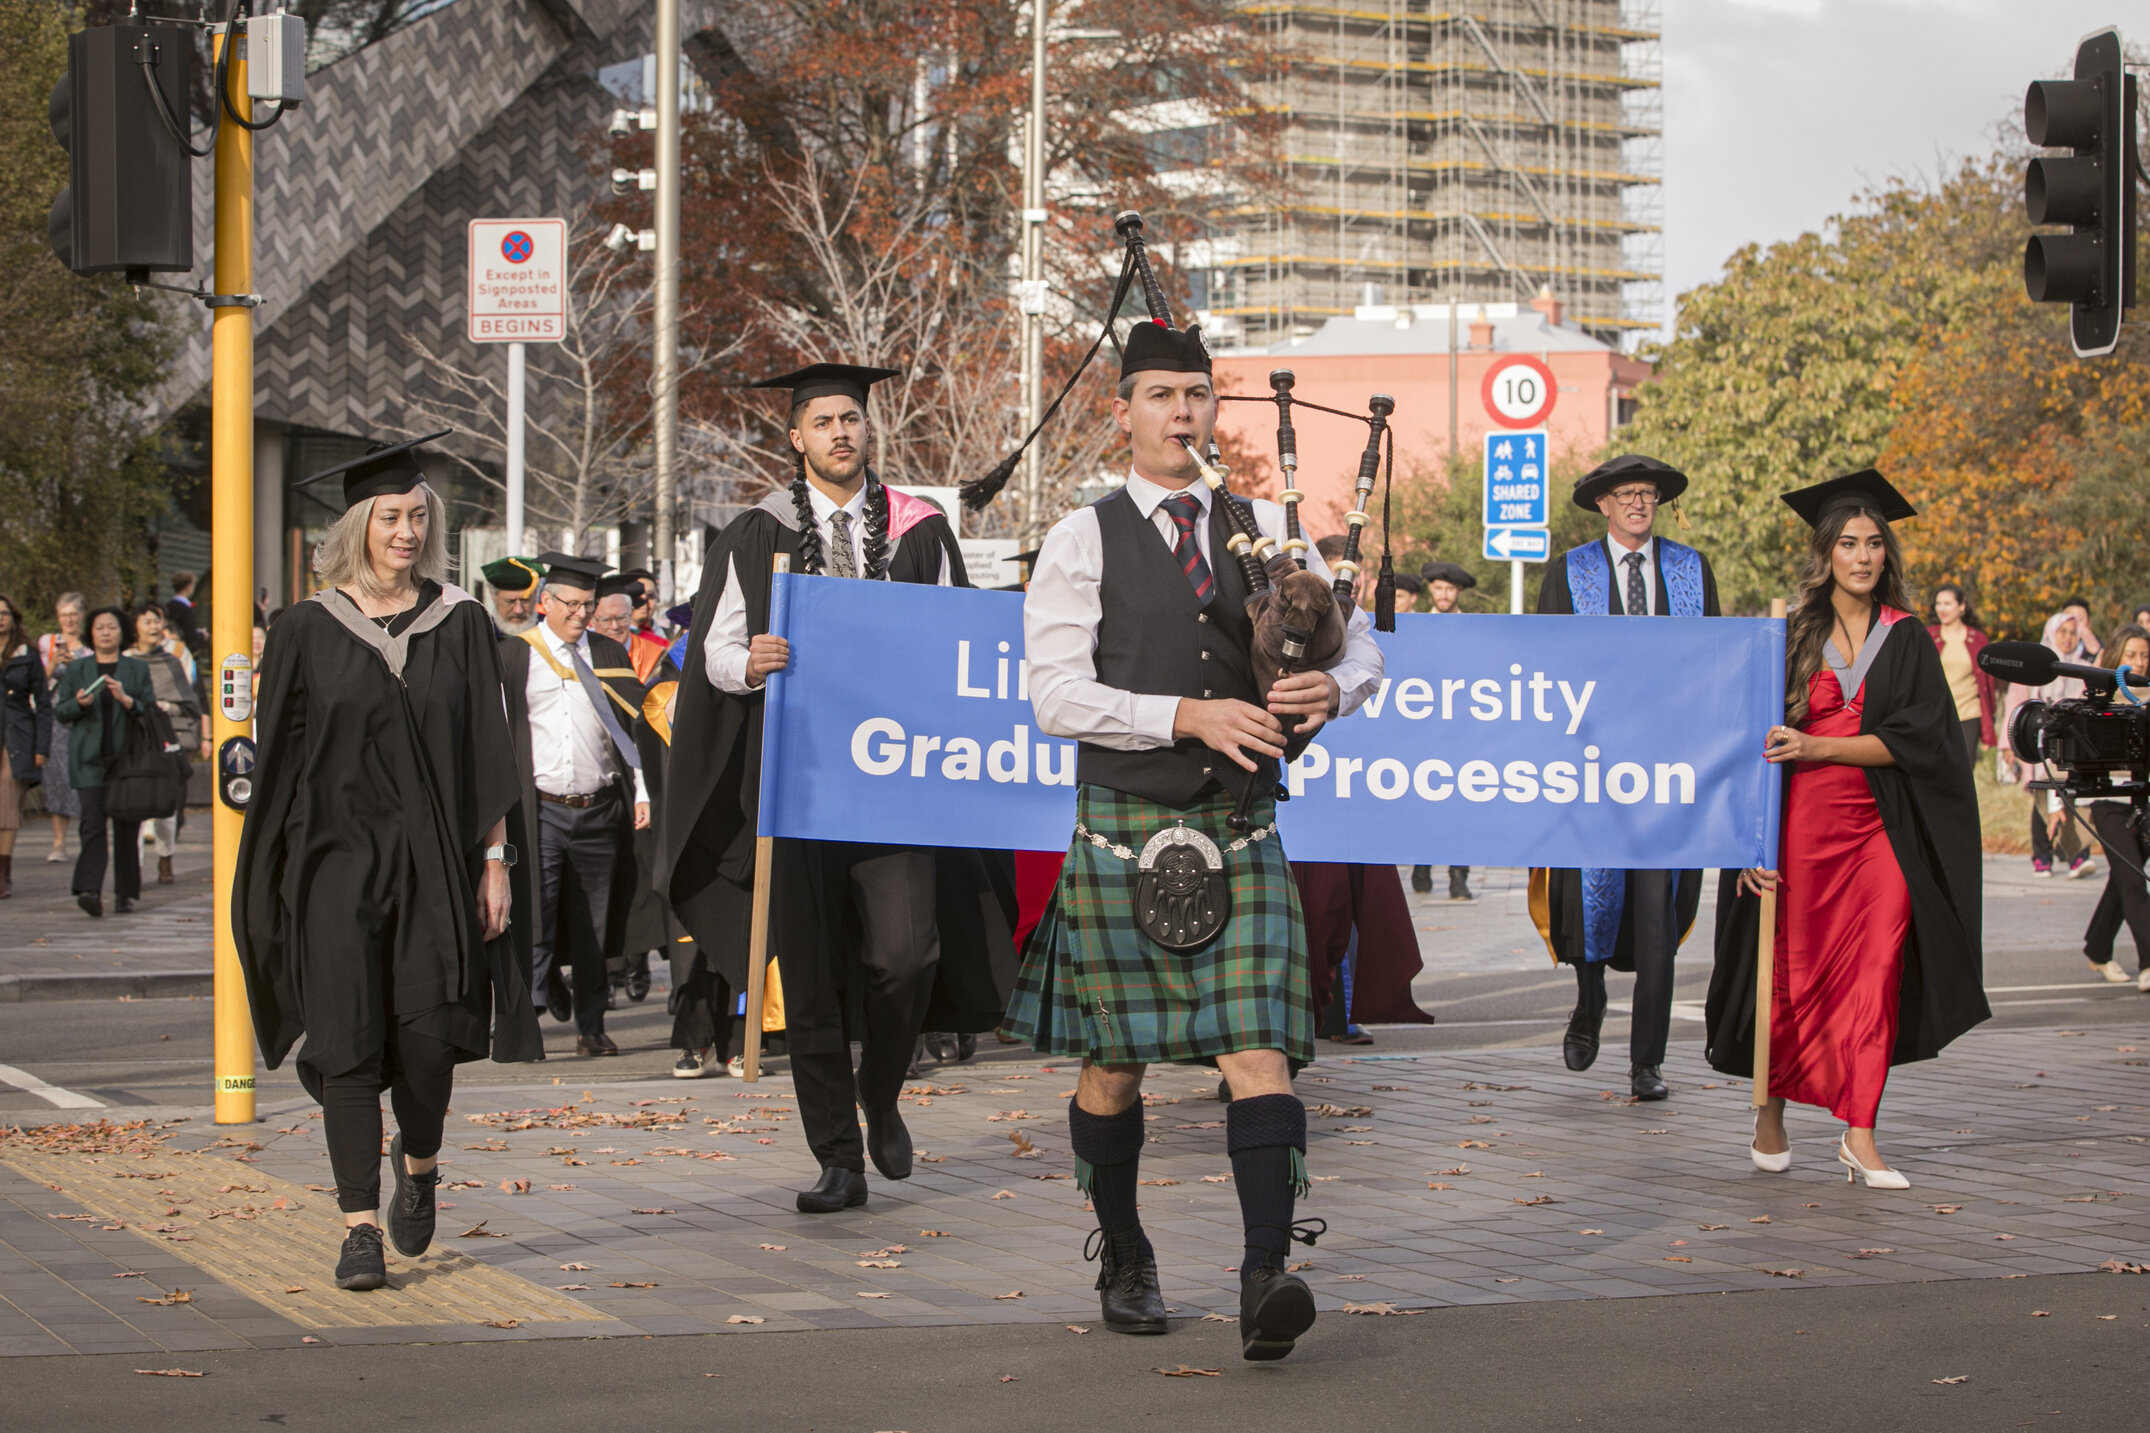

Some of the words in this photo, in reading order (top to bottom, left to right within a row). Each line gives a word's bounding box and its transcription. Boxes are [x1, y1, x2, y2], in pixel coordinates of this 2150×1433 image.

[486, 269, 533, 282] Except
[538, 268, 550, 280] in
[478, 283, 557, 296] Signposted
[498, 298, 537, 309] Areas
[481, 319, 553, 333] BEGINS
[1505, 378, 1535, 404] 10
[1492, 484, 1540, 502] SHARED
[1499, 503, 1532, 520] ZONE
[957, 640, 1029, 700] Li
[1363, 663, 1597, 735] versity
[851, 717, 1075, 786] Gradu
[1287, 742, 1696, 804] Procession
[224, 1078, 256, 1089] DANGE
